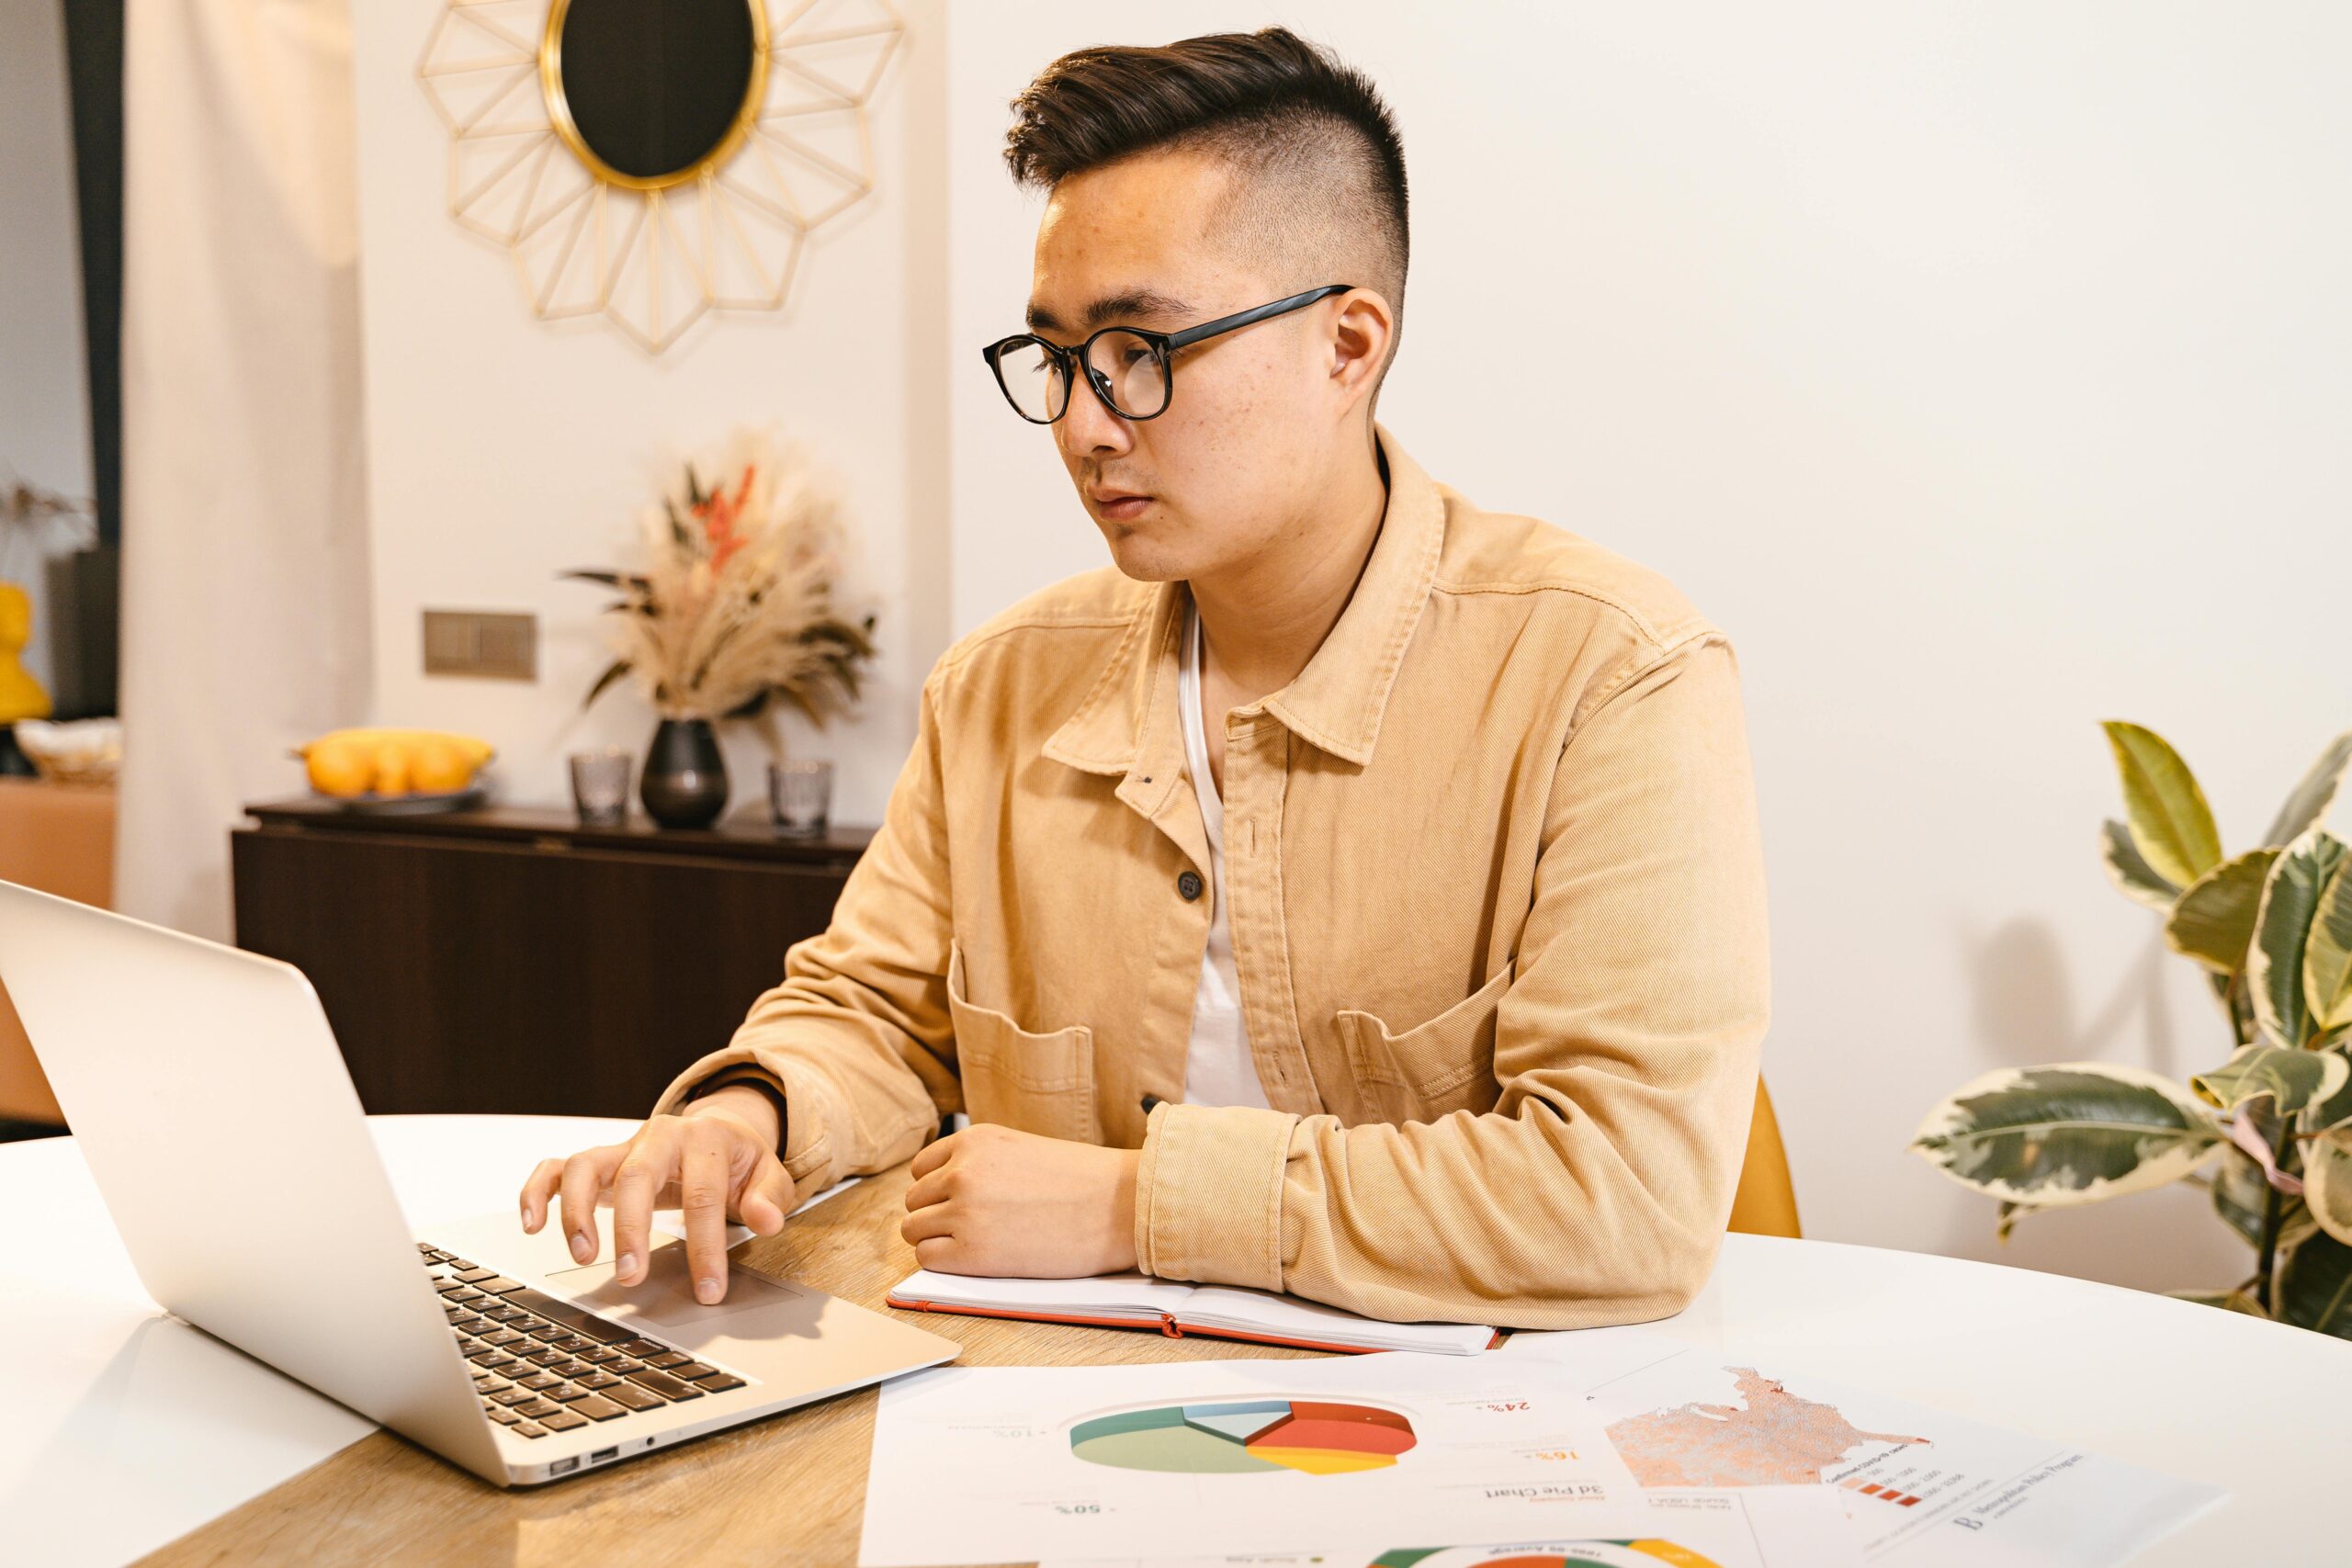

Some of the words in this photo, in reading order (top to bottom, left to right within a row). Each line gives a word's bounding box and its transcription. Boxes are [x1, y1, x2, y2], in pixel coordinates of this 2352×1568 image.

[1487, 1402, 1531, 1413] 24%
[1535, 1451, 1579, 1461] 16%
[1485, 1486, 1538, 1499] Chart
[1543, 1485, 1574, 1495] Pie
[1579, 1484, 1604, 1495] 3d
[1055, 1504, 1102, 1515] 50%
[1952, 1516, 1984, 1531] B
